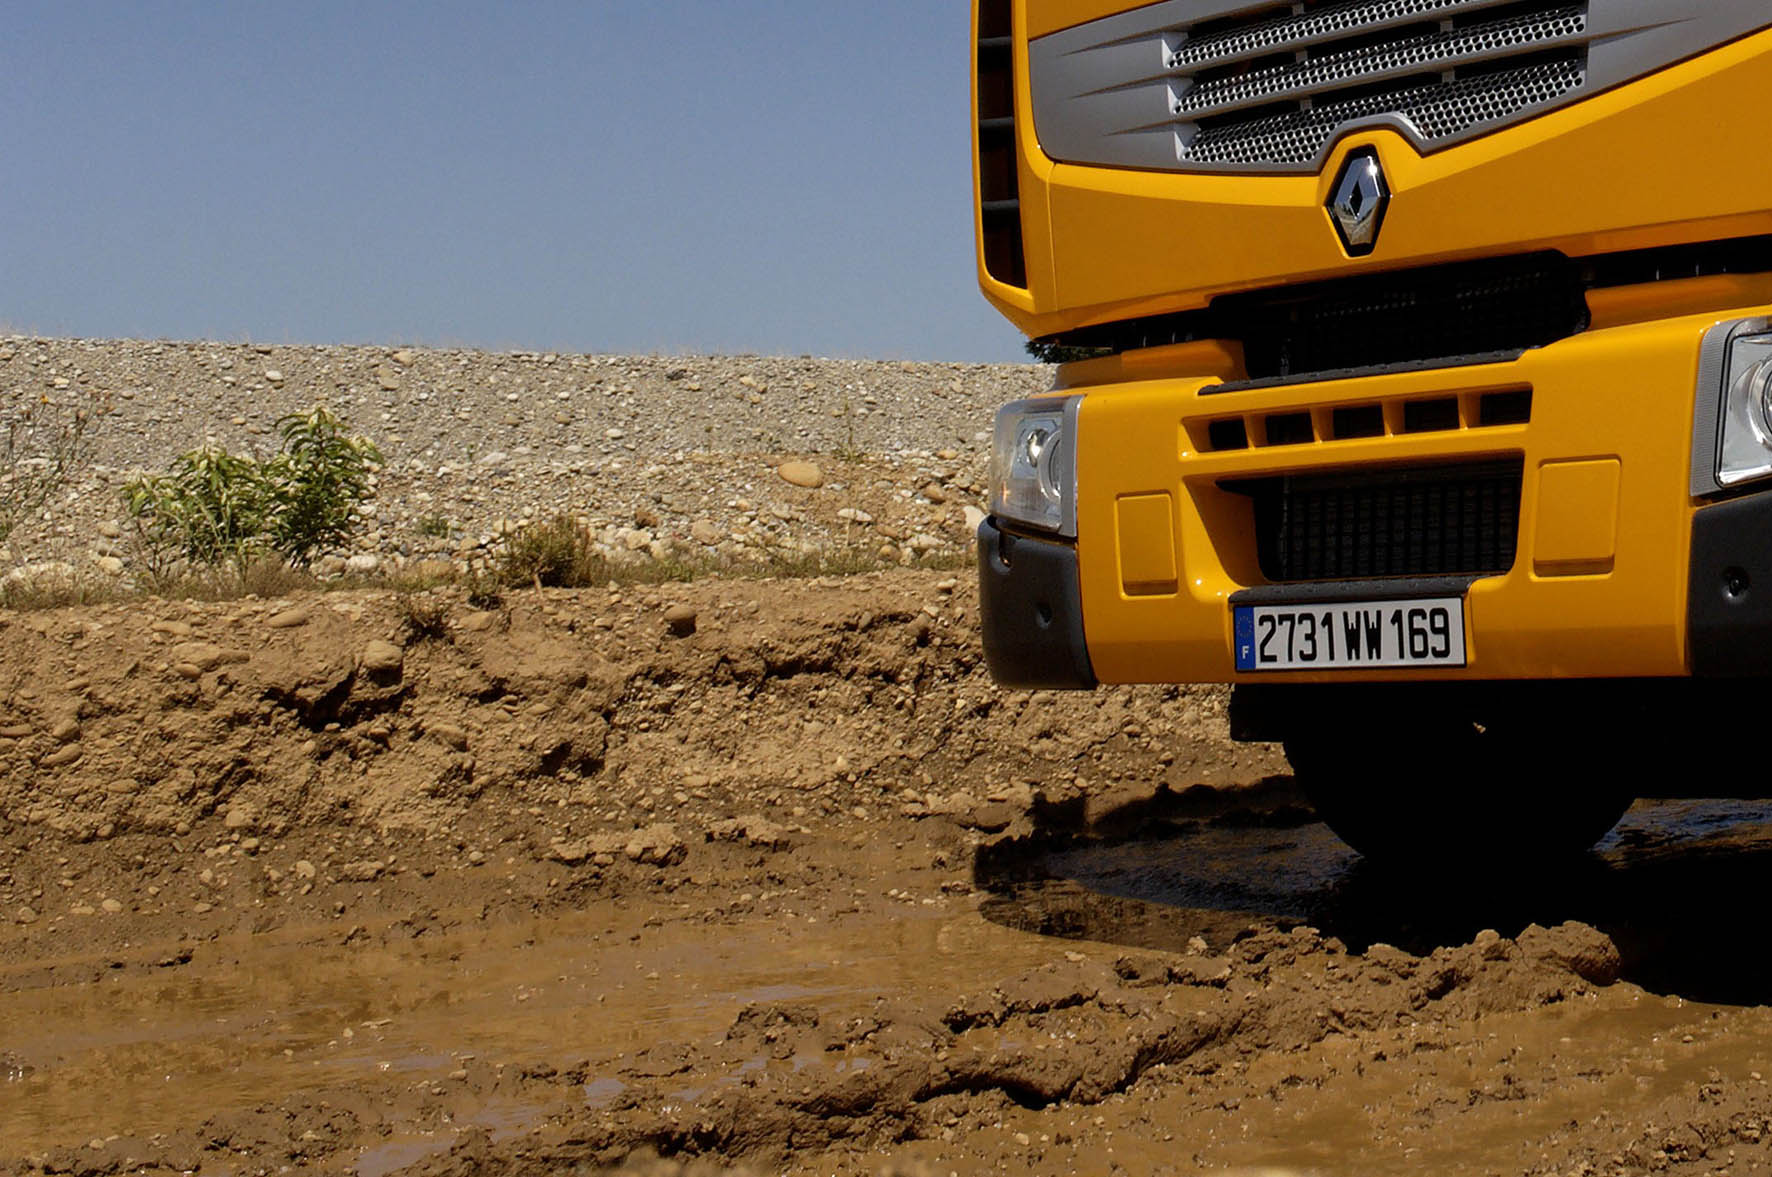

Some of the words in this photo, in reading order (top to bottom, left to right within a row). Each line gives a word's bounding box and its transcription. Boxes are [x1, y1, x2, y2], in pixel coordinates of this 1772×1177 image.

[1241, 645, 1250, 660] F
[1258, 611, 1335, 663] 2731
[1342, 609, 1382, 661] WW
[1390, 607, 1451, 660] 169
